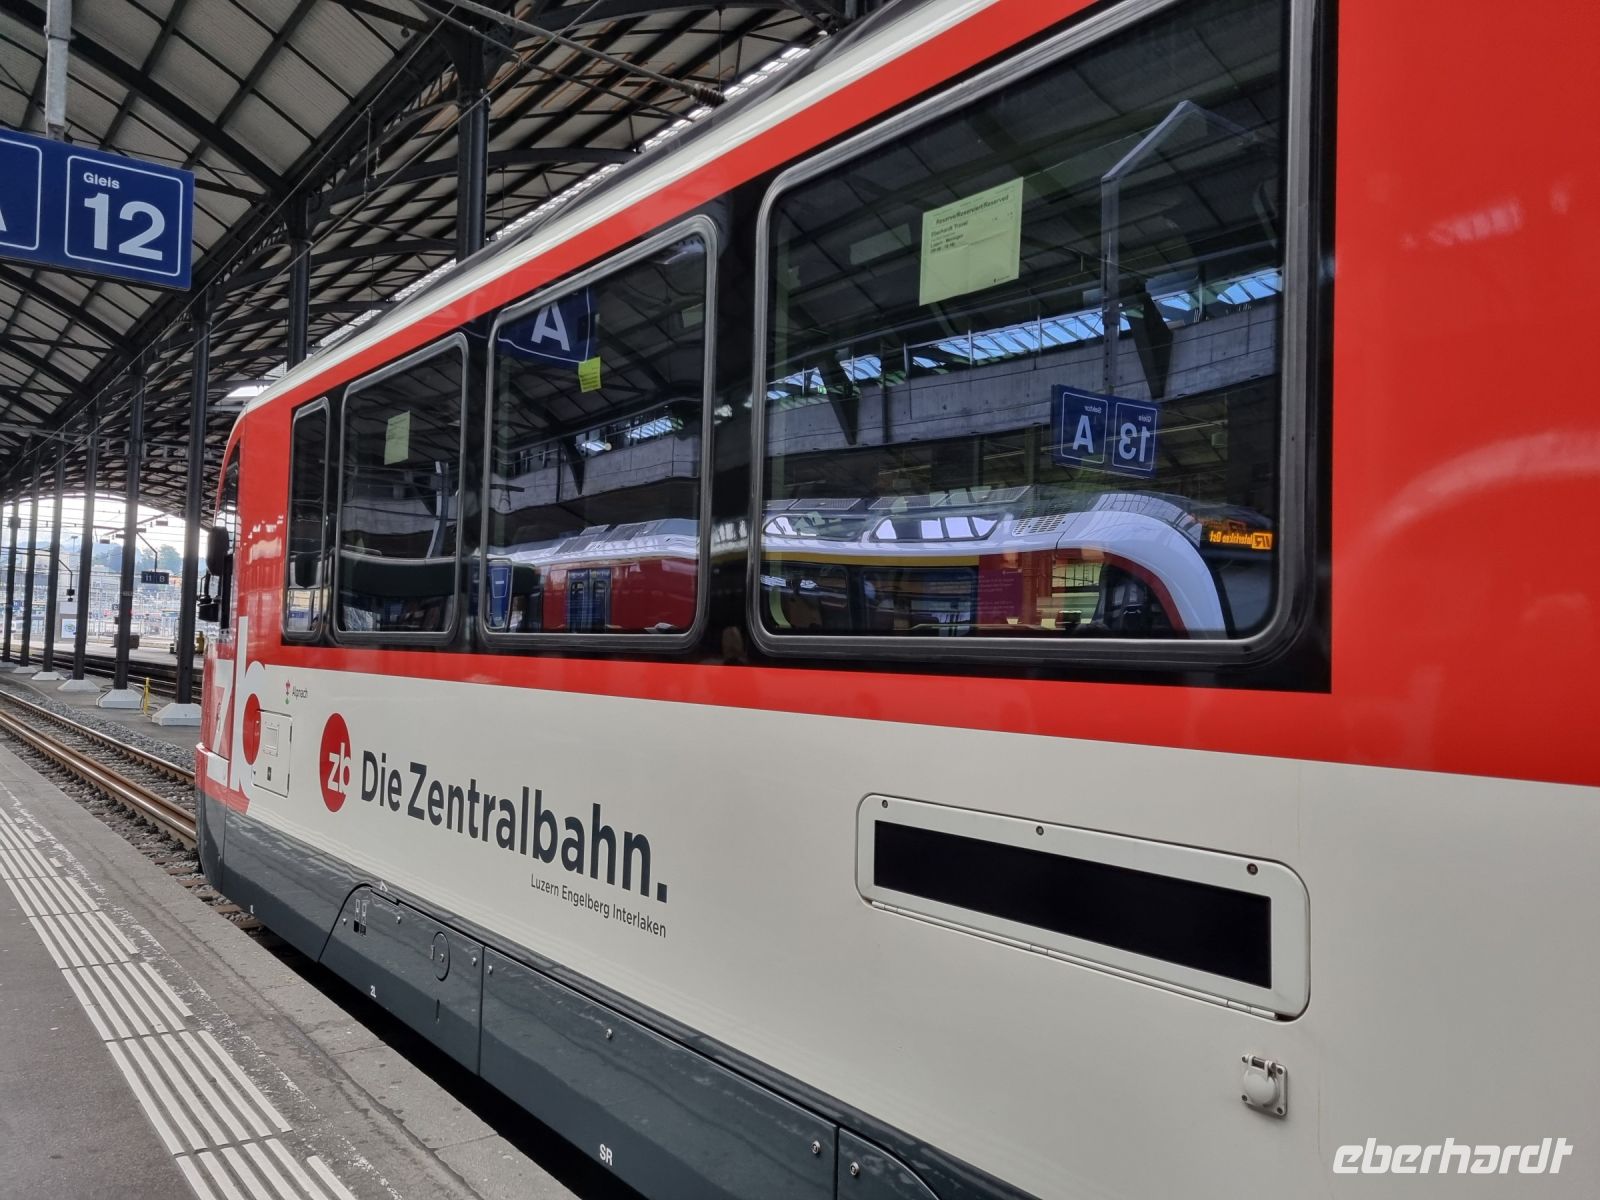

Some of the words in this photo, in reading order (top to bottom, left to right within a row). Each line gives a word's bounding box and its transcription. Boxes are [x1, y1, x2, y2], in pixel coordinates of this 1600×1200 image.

[83, 172, 120, 190] Gleis
[84, 192, 166, 261] 12
[327, 743, 352, 793] zb
[361, 750, 402, 812] Die
[407, 761, 668, 904] Zentralbahn.
[530, 873, 560, 898] Luzern
[561, 885, 610, 919] Engelberg
[612, 904, 667, 938] Interlaken
[599, 1143, 613, 1167] SR
